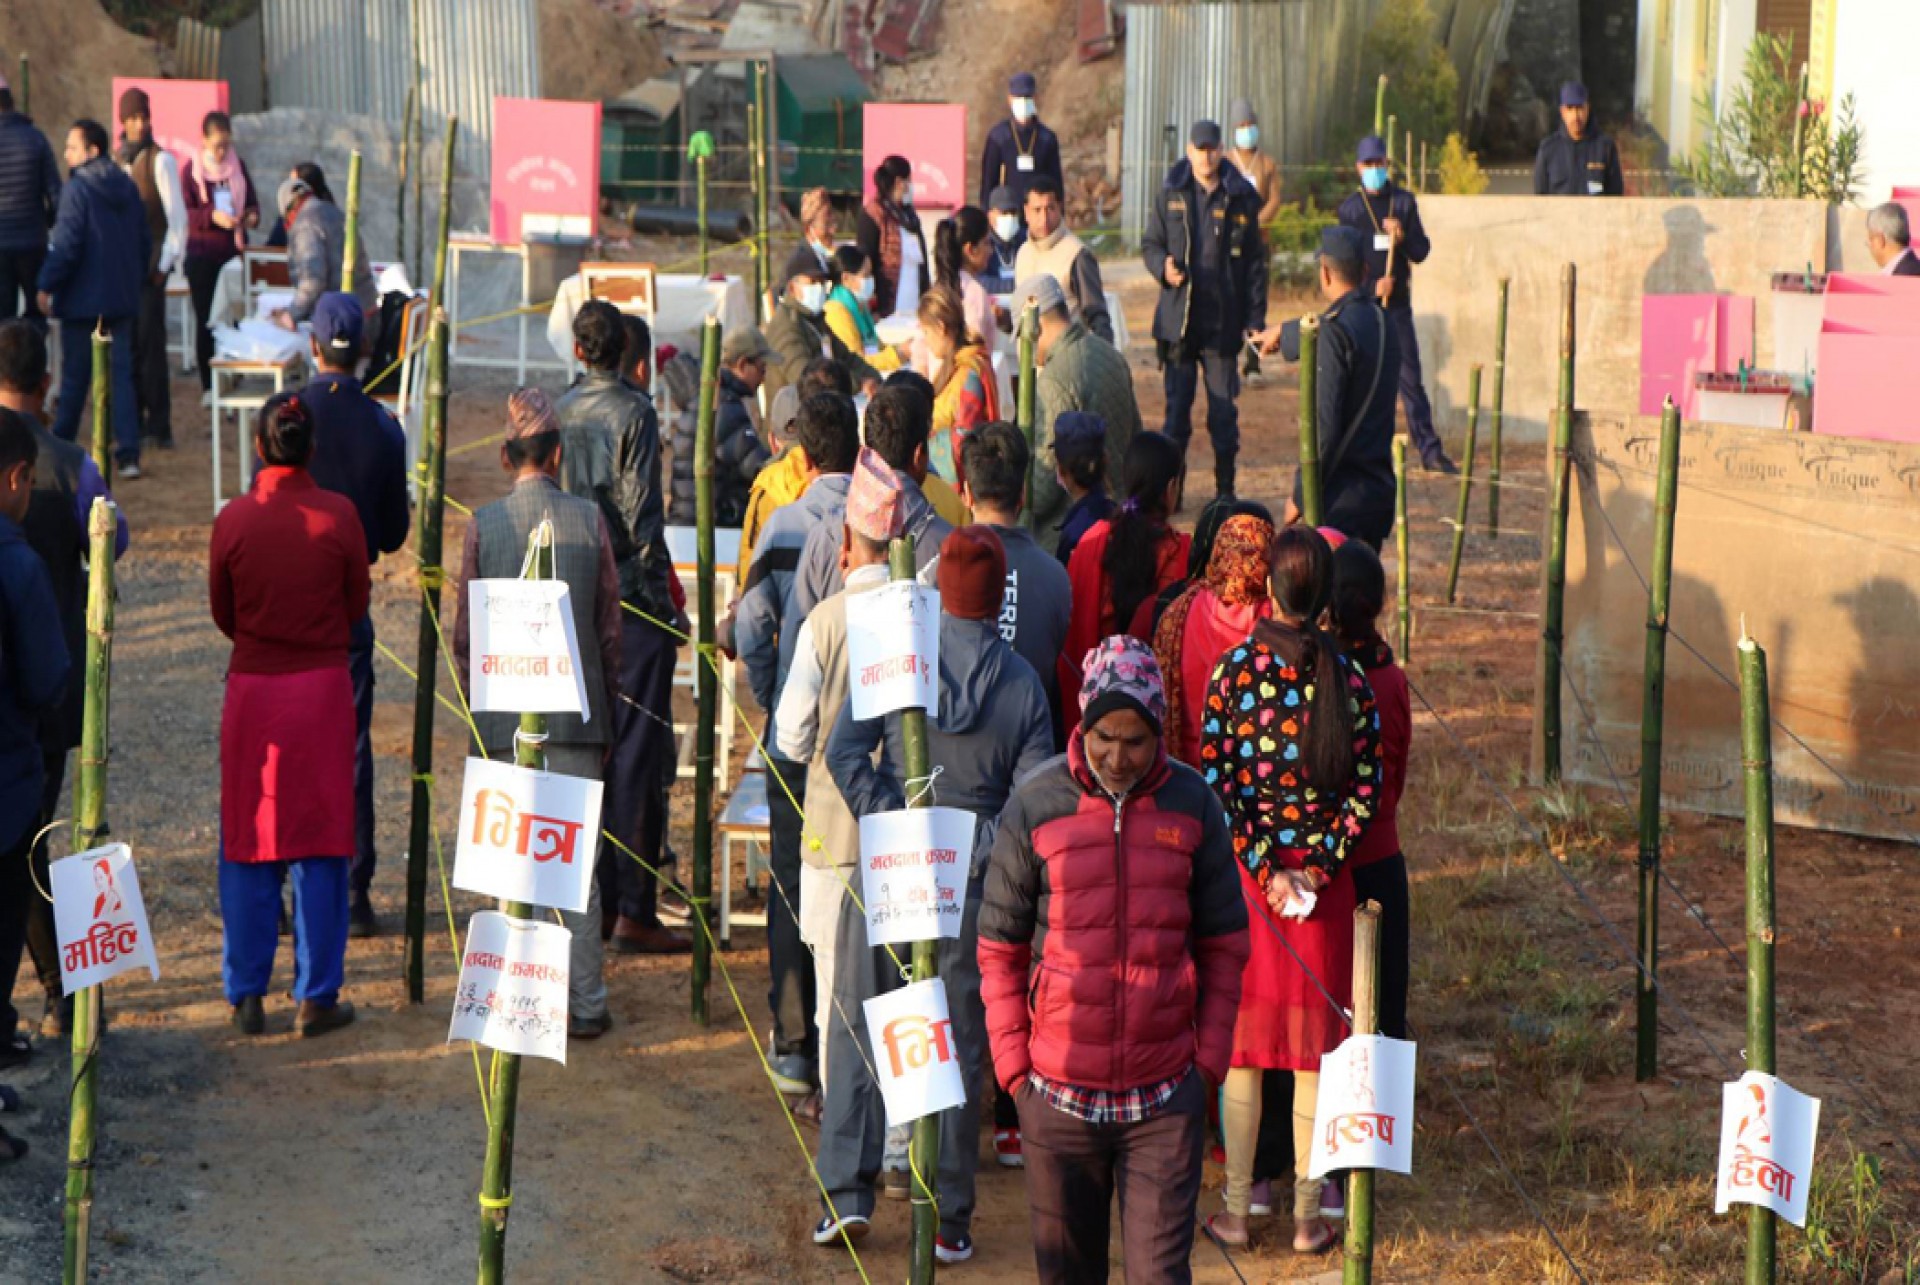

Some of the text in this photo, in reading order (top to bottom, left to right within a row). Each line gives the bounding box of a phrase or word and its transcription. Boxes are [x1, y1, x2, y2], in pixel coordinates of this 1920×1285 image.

[1813, 459, 1881, 490] Unique
[999, 569, 1018, 643] TERR
[482, 654, 549, 677] मतदान
[860, 654, 917, 687] मतदान
[472, 788, 584, 864] भित्र
[64, 921, 138, 973] महिल
[883, 1014, 955, 1077] भि
[1728, 1143, 1796, 1203] हिला
